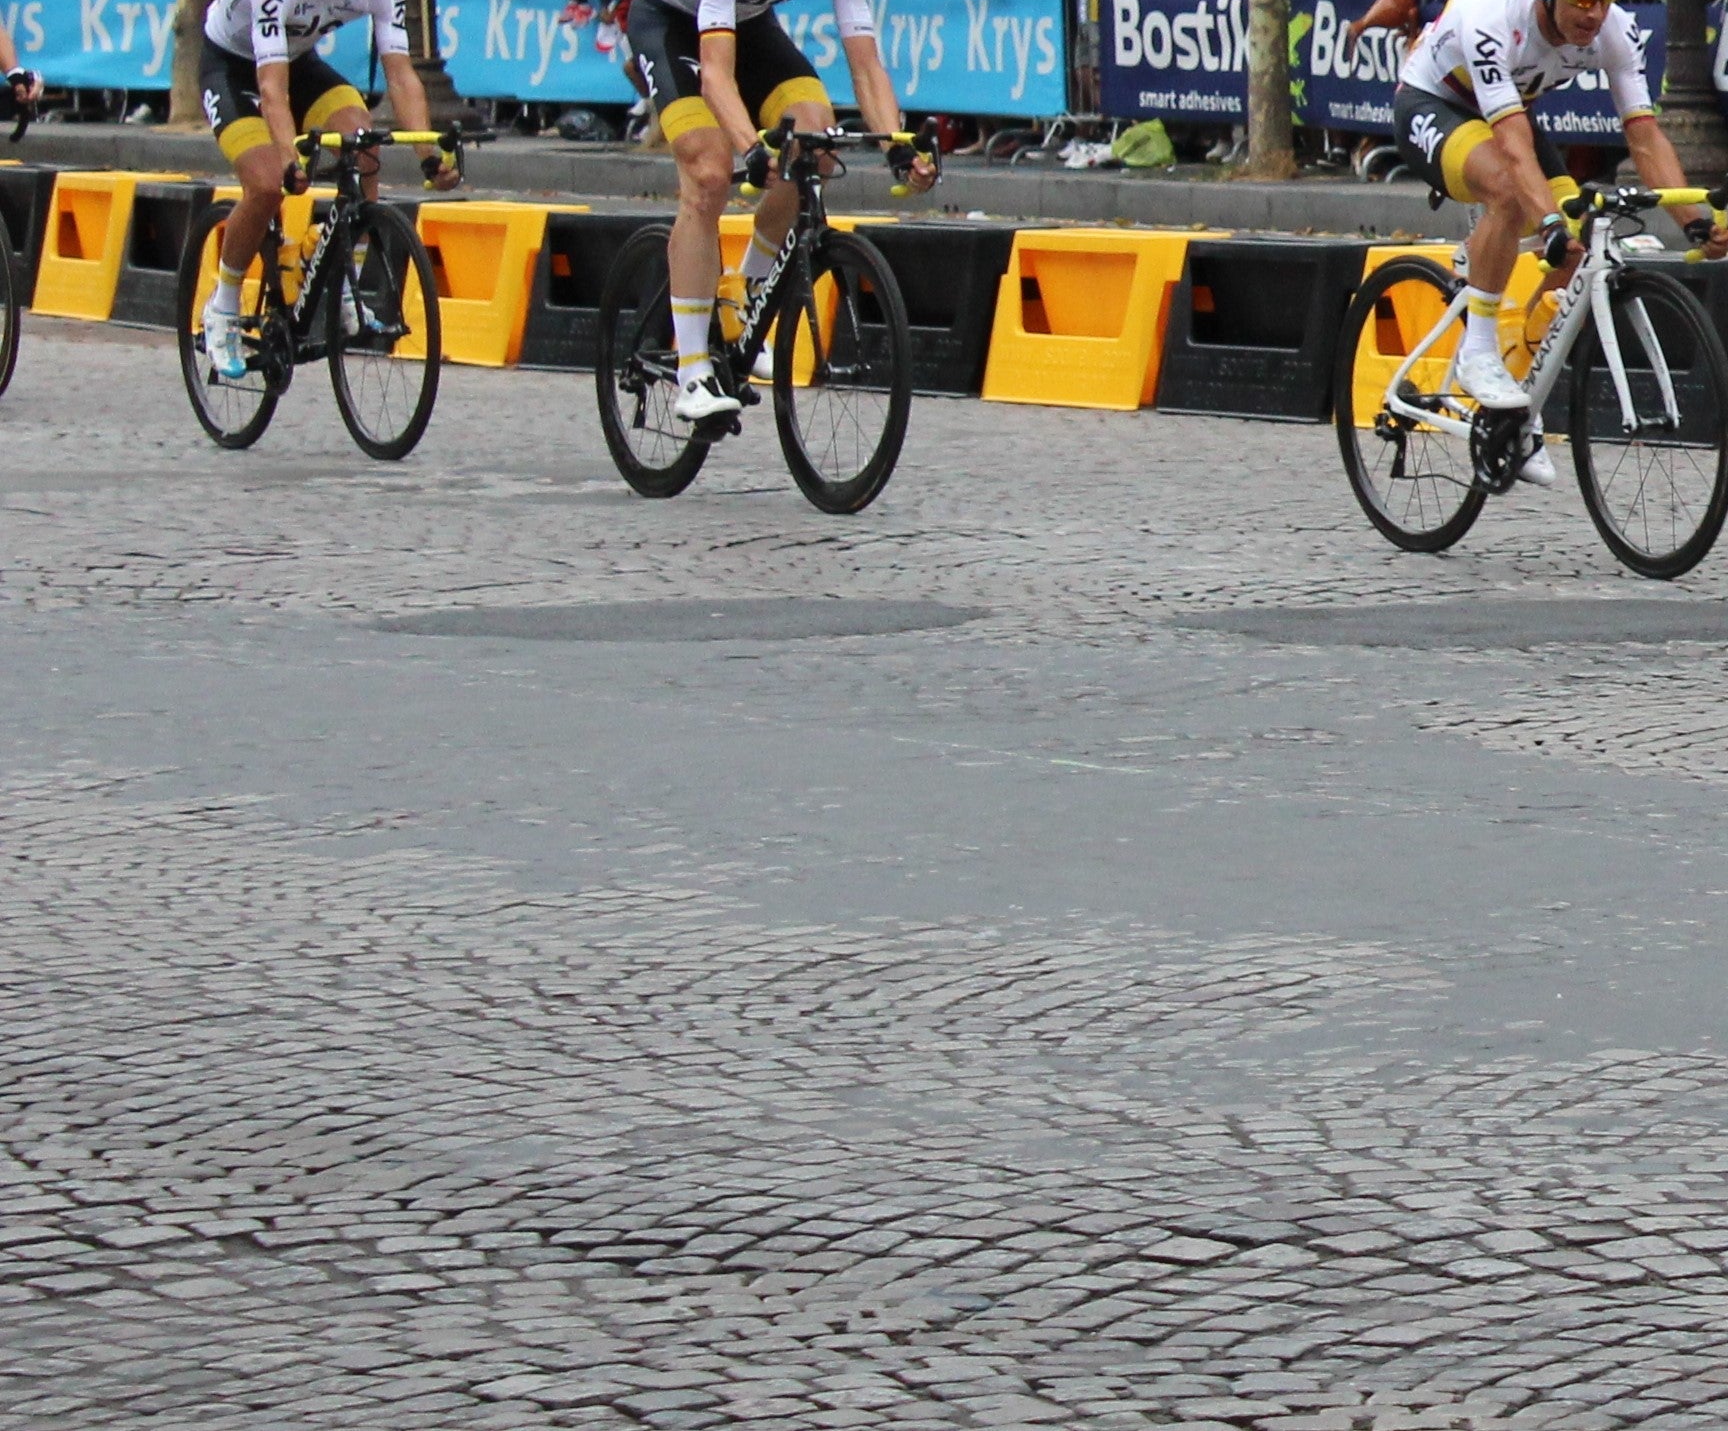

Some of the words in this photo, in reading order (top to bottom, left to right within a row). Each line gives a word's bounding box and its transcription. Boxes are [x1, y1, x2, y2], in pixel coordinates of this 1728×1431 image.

[1138, 91, 1176, 110] smart
[1178, 90, 1242, 113] adhesives
[1553, 111, 1622, 134] adhesive
[737, 227, 797, 355] PINARELLO
